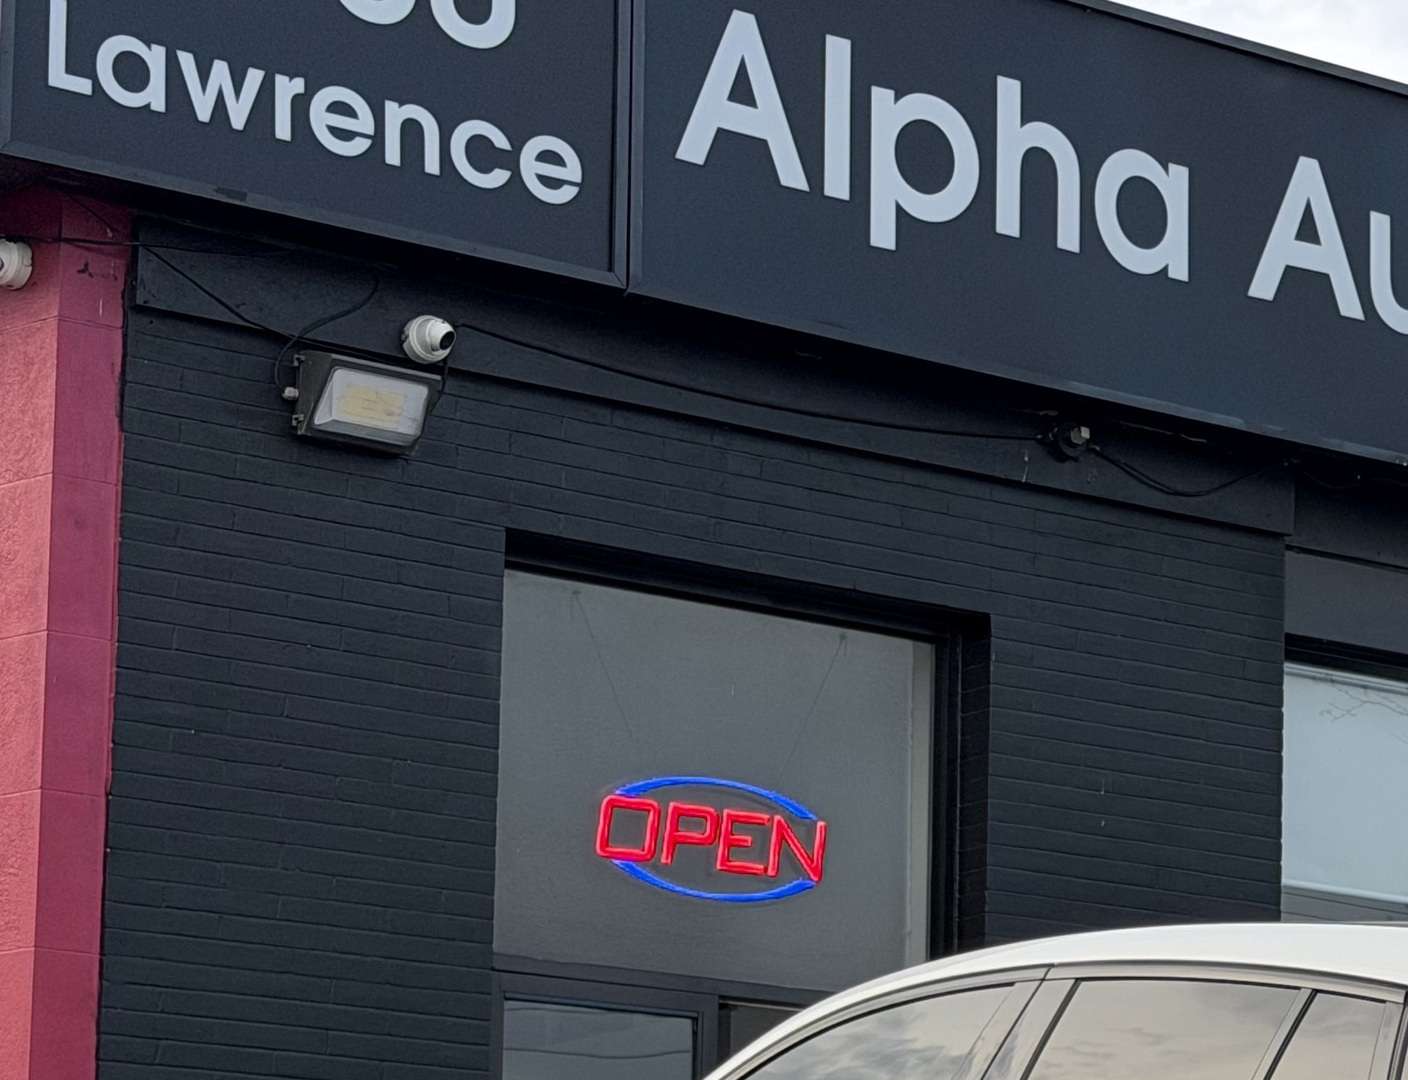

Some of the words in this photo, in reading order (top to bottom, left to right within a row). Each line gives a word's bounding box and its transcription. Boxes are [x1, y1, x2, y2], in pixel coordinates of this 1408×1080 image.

[47, 0, 582, 205] Lawrence
[675, 9, 1190, 283] Alpha
[596, 795, 827, 883] OPEN
